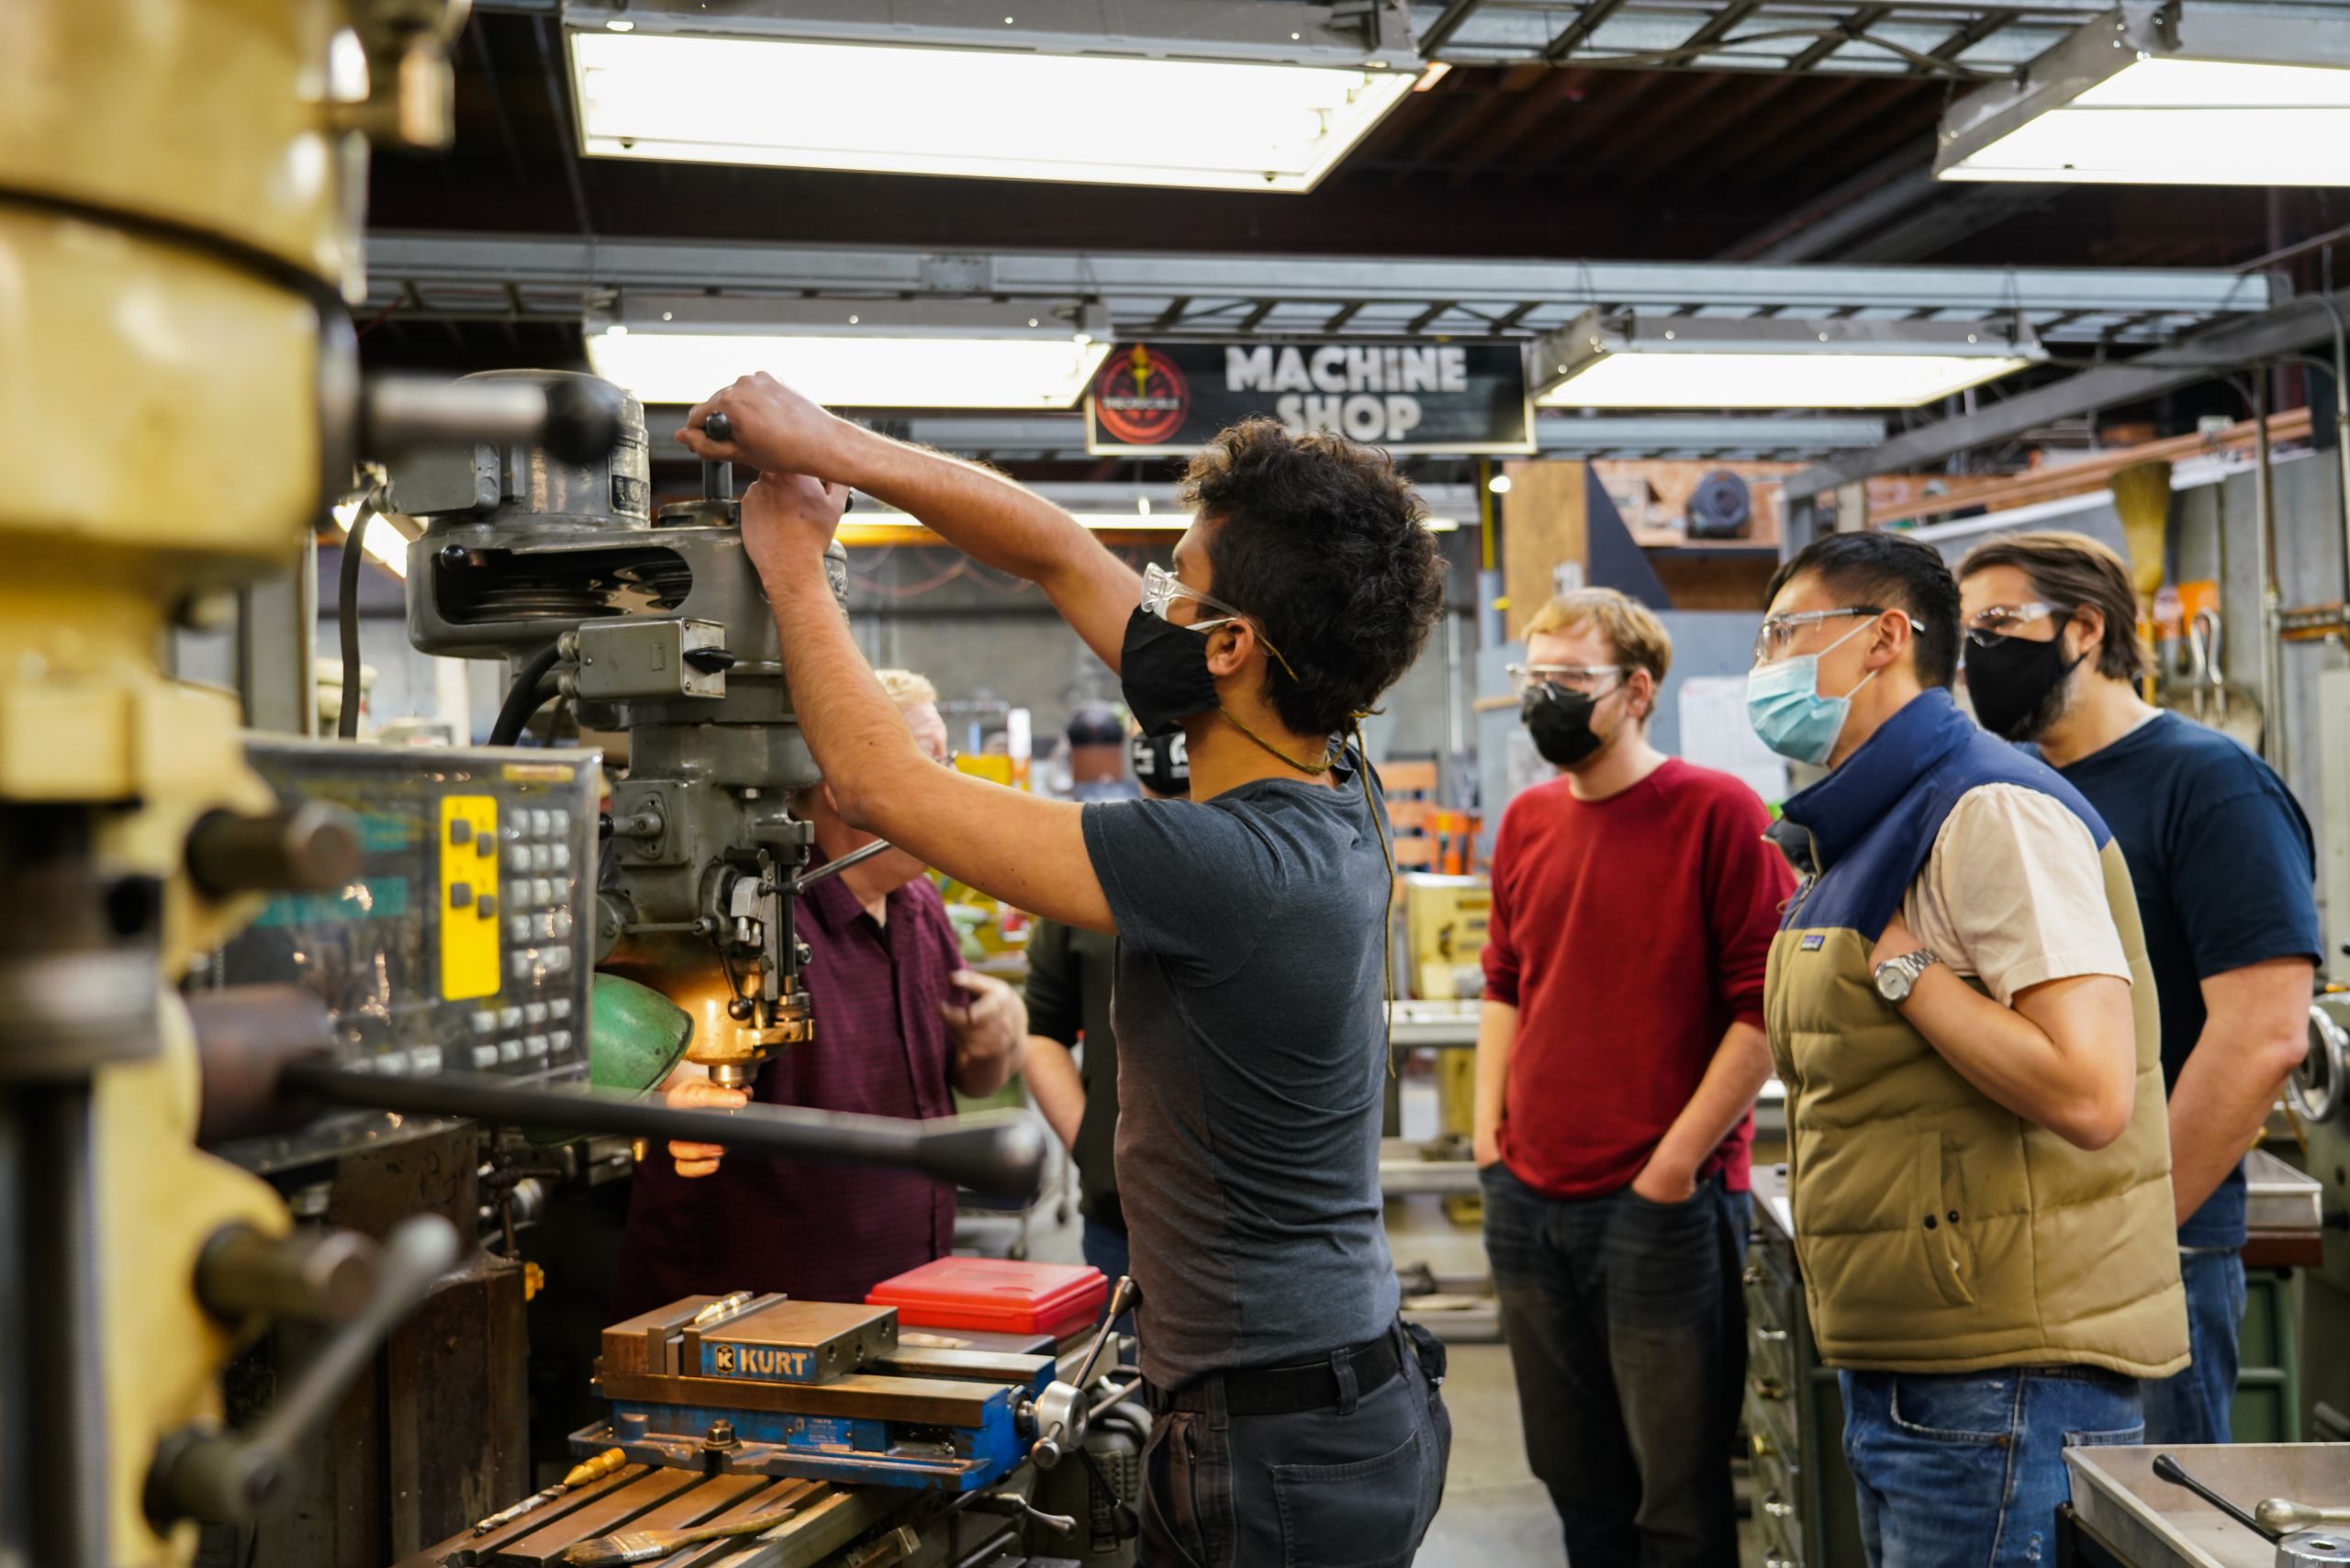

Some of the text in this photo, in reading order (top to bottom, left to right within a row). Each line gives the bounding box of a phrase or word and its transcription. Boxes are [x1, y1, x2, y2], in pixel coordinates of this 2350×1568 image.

[1225, 346, 1467, 392] MACHINE
[1276, 395, 1421, 442] SHOP
[718, 1349, 807, 1375] K KURT
